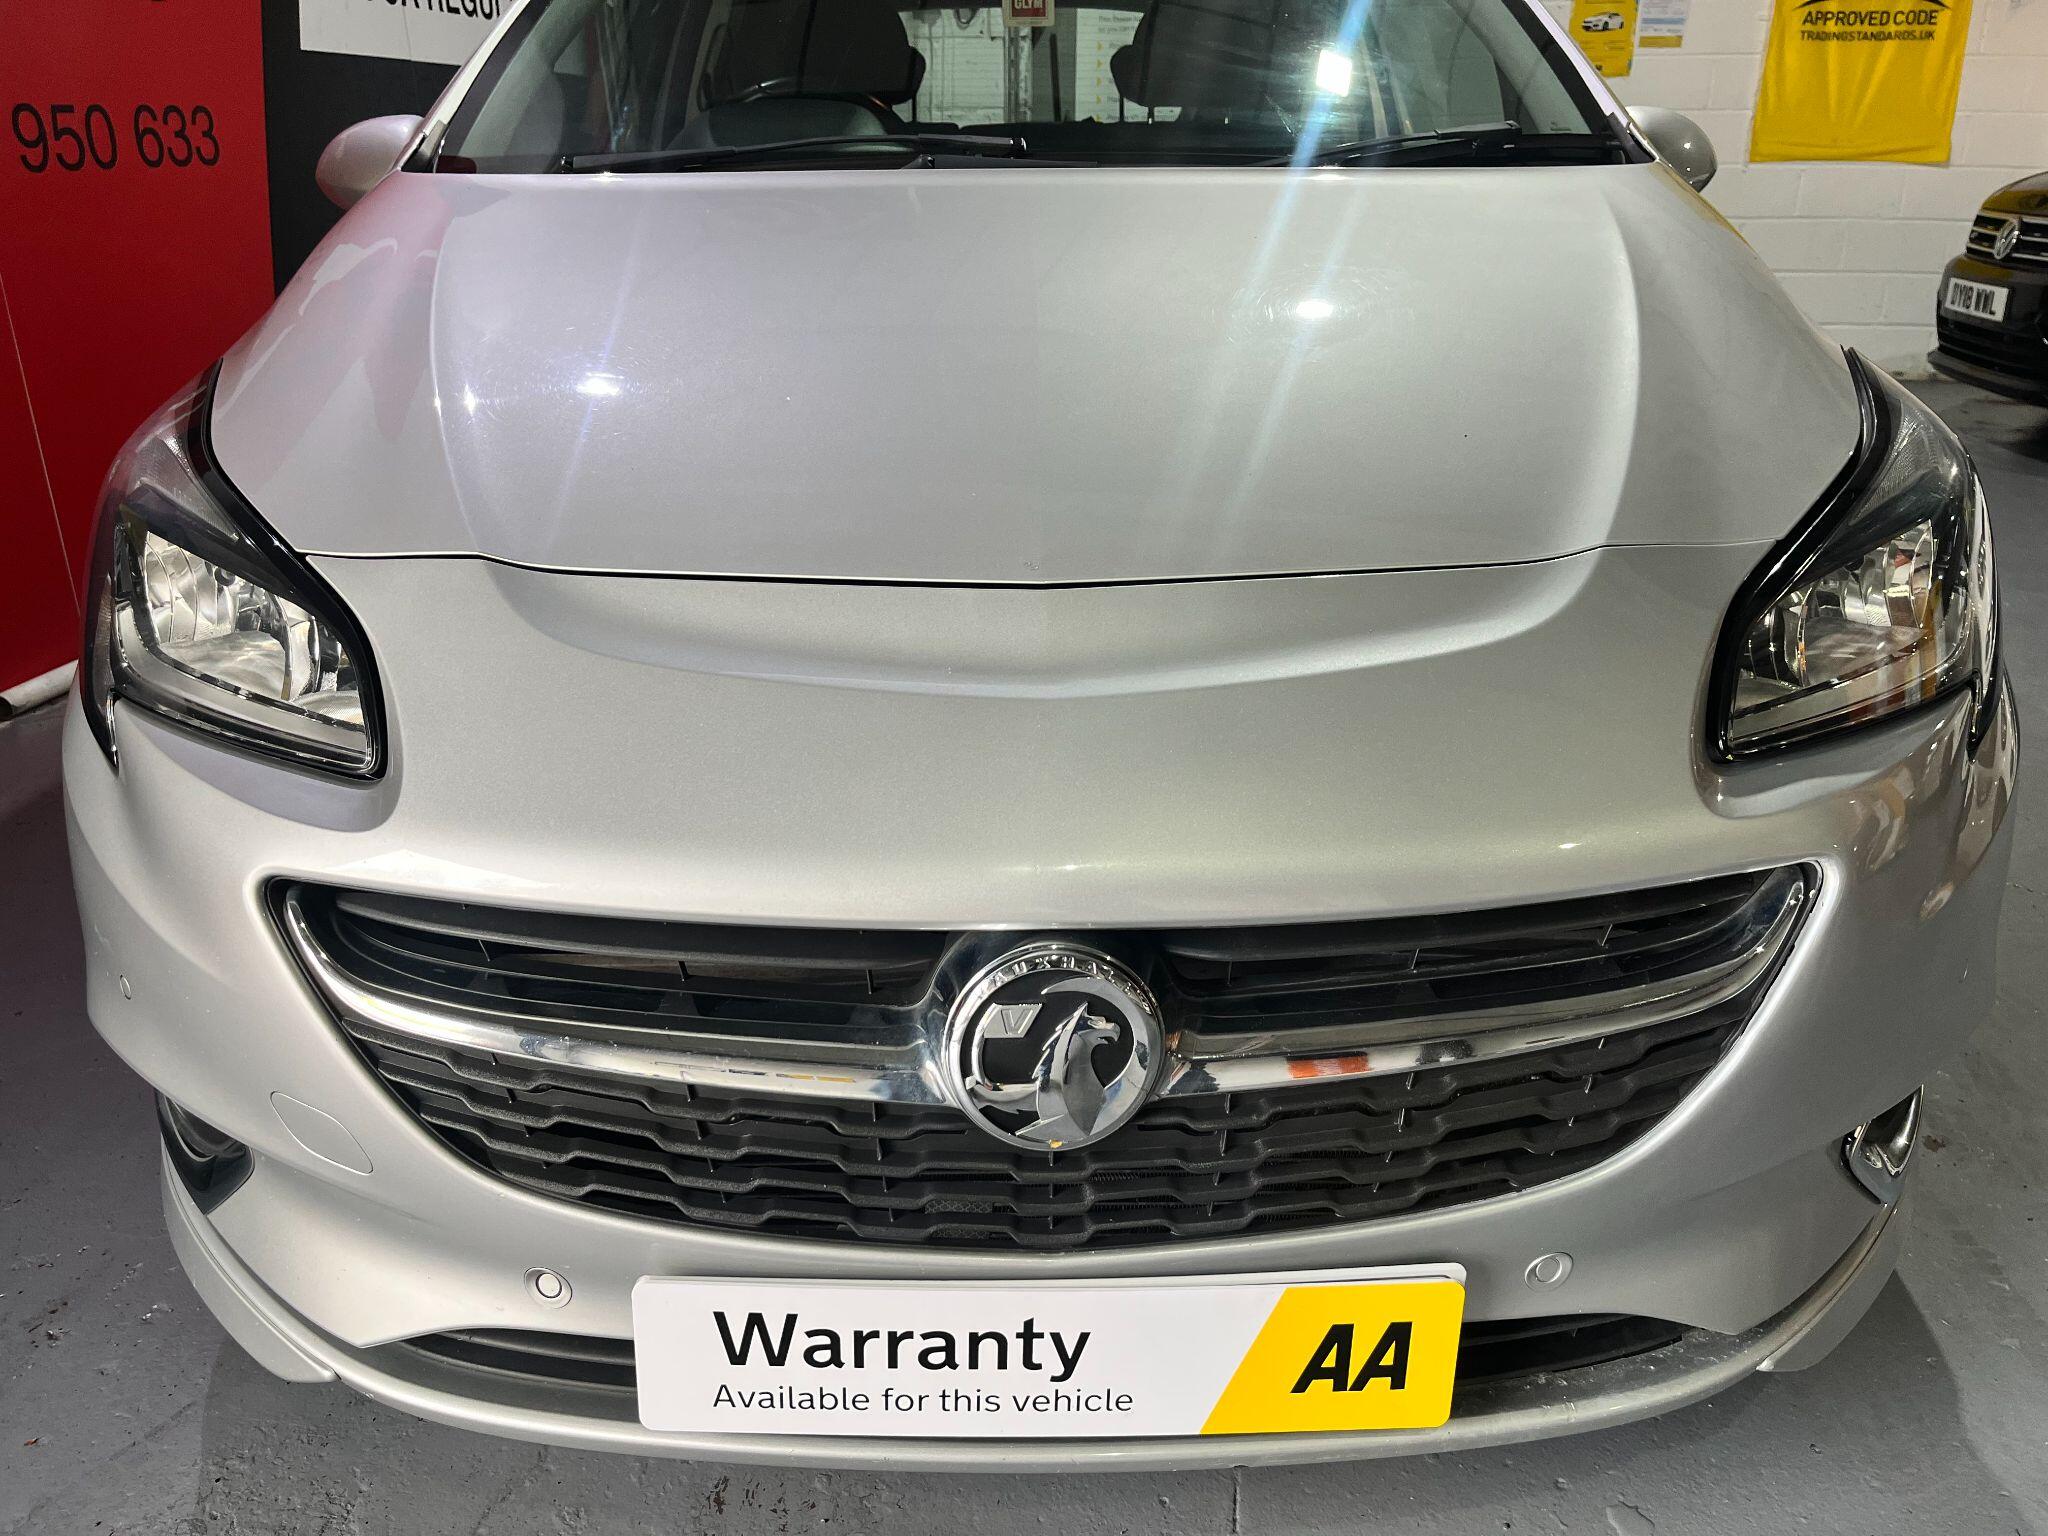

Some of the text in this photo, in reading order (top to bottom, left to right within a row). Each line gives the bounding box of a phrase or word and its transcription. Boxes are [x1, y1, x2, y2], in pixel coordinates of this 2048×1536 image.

[1801, 30, 1935, 41] TRADINGSTANDARDS.UK
[1802, 10, 1938, 26] APPROVED CODE
[12, 103, 220, 173] 950 633
[713, 1311, 1091, 1382] Warranty
[1290, 1321, 1413, 1394] AA
[713, 1384, 1133, 1412] Available for this vehicle
